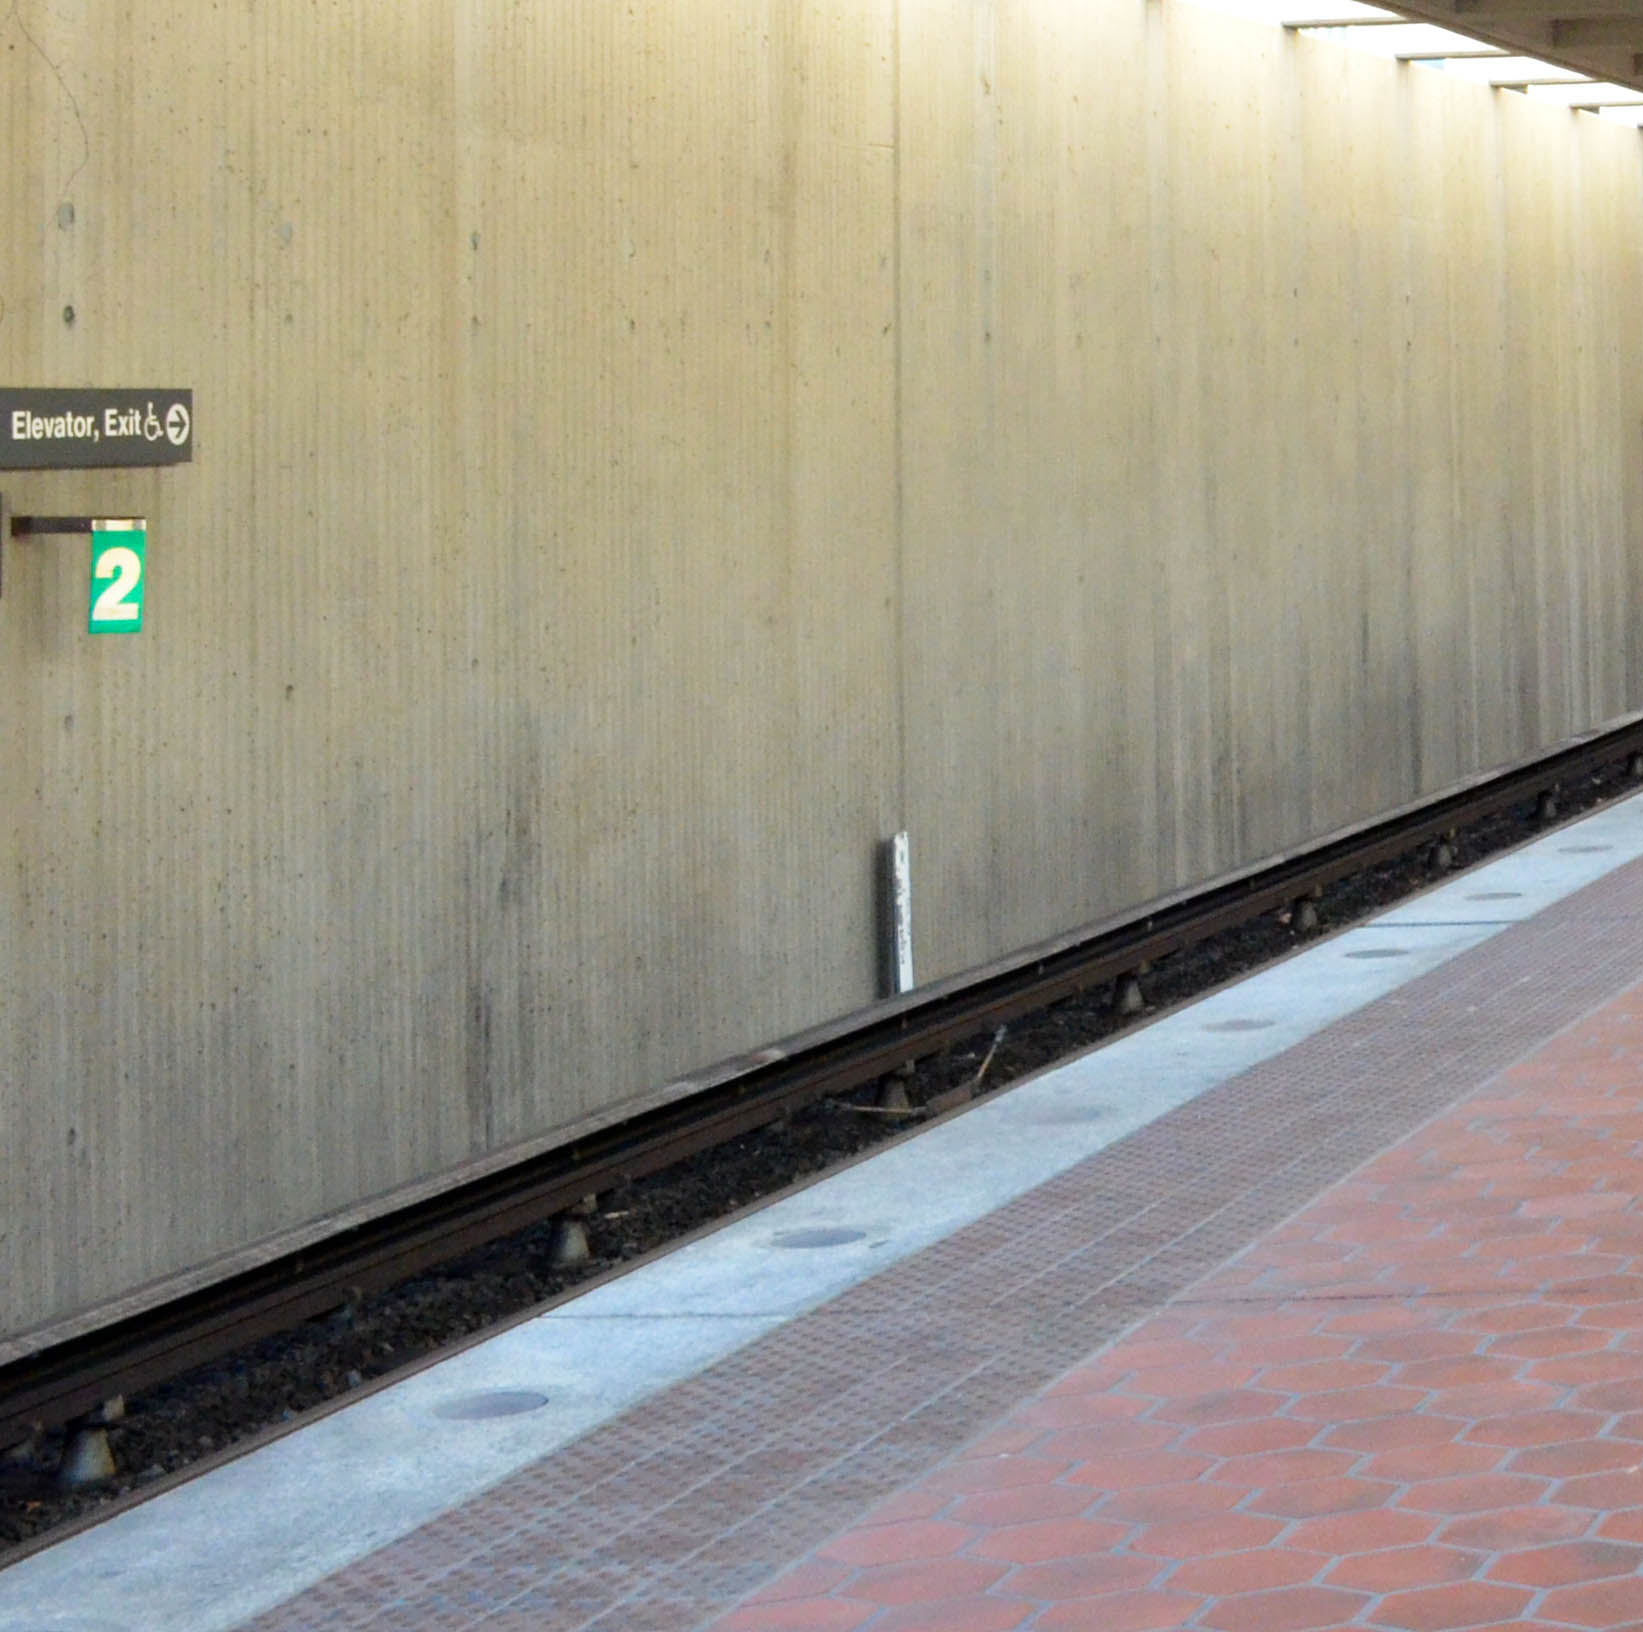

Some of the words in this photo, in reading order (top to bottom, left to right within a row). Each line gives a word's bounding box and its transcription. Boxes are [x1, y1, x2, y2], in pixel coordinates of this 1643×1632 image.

[12, 410, 99, 442] Elevator,
[104, 408, 141, 437] Exit
[92, 547, 141, 621] 2
